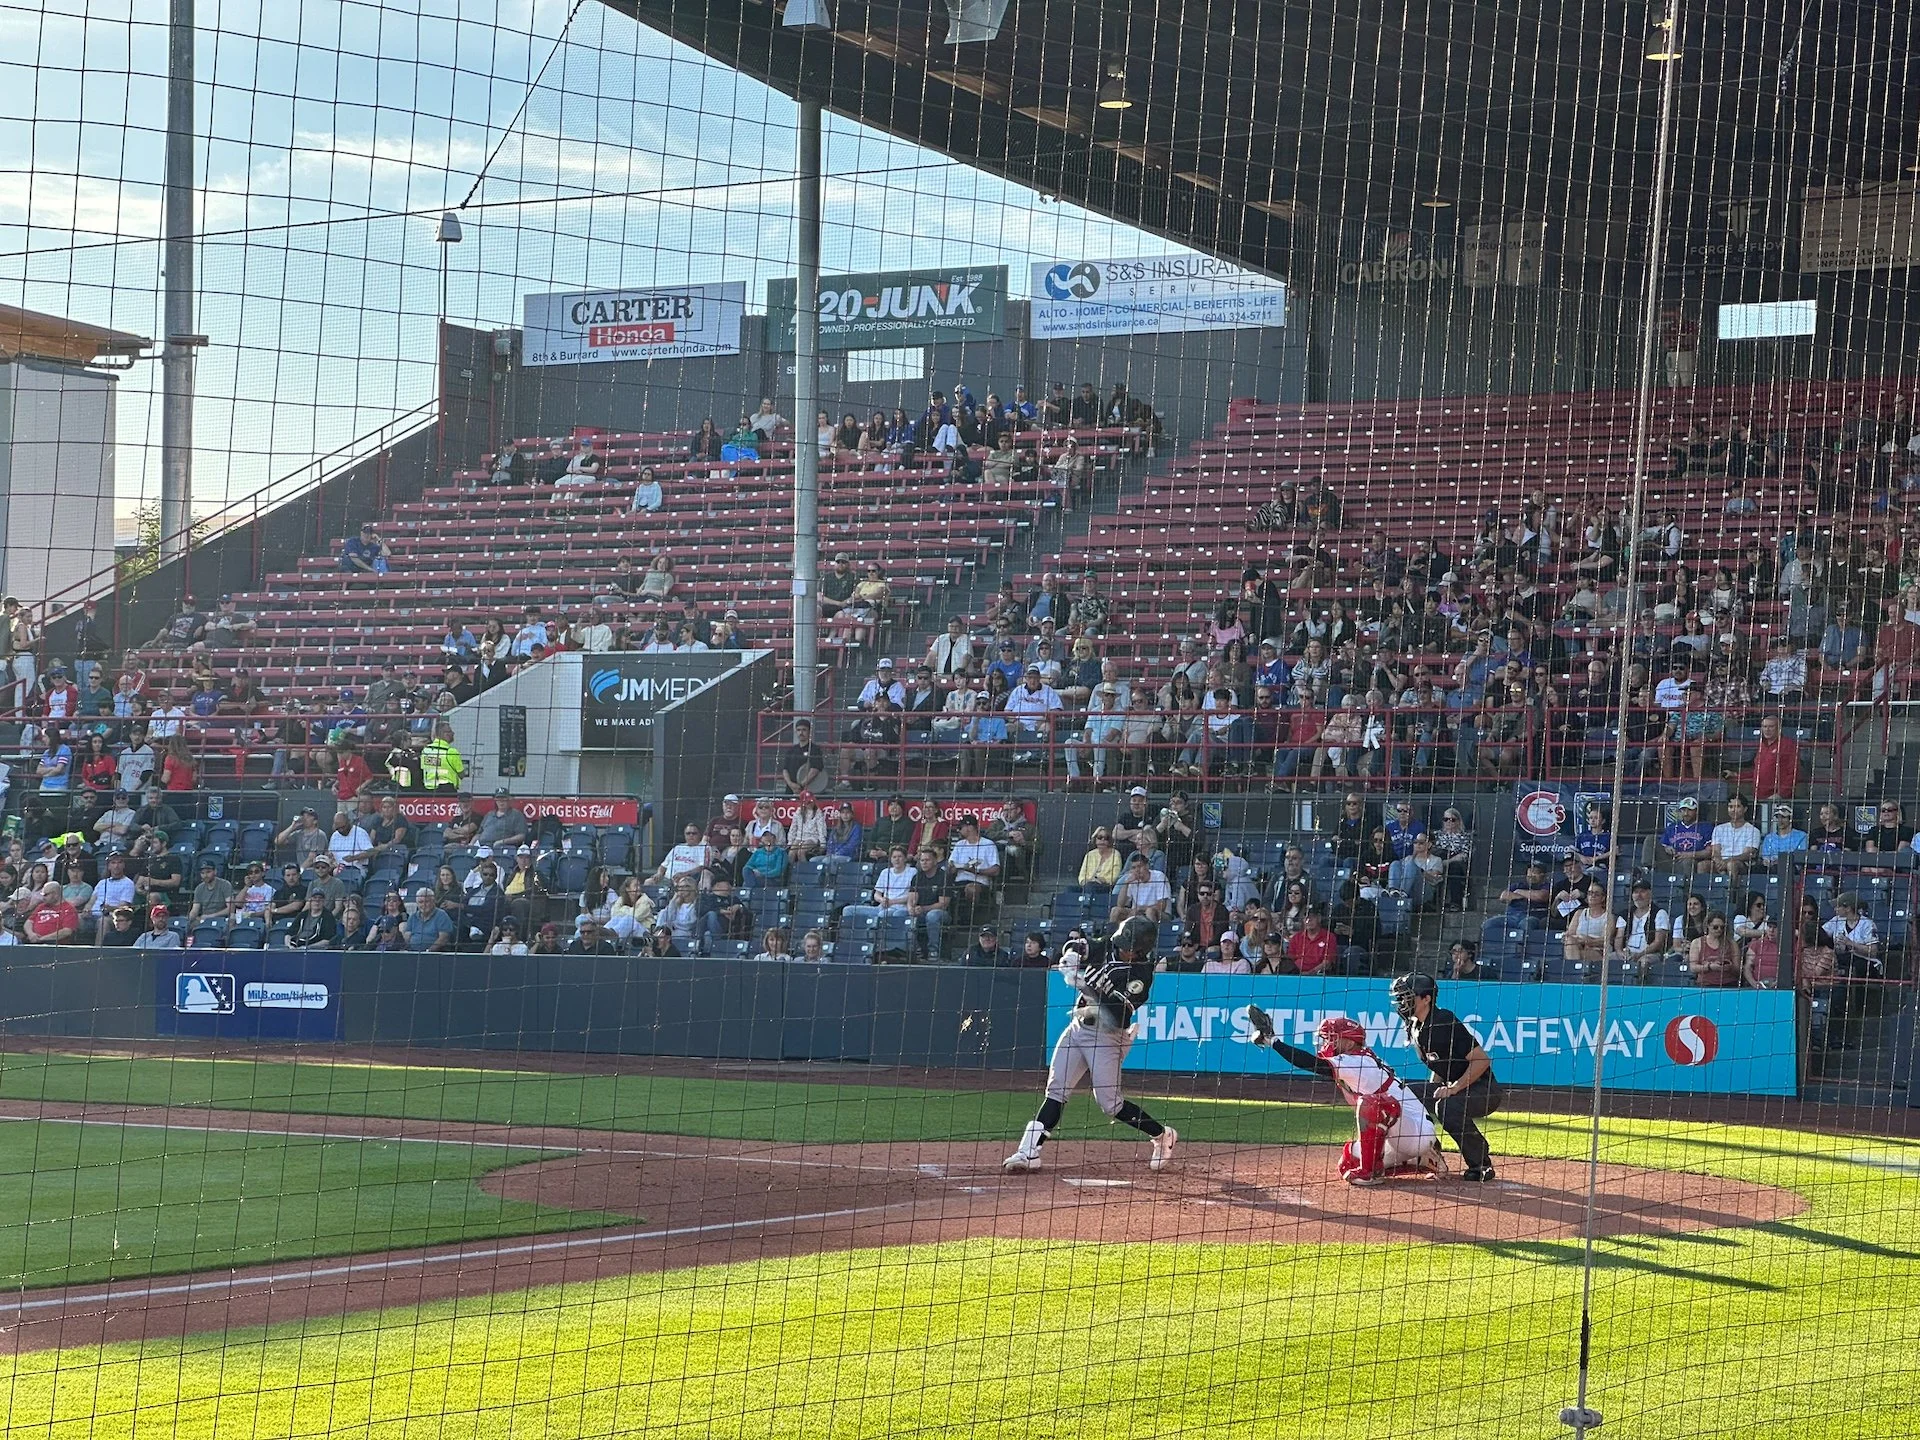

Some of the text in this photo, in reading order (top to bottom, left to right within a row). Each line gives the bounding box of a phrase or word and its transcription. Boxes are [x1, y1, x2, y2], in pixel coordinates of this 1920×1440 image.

[1105, 262, 1145, 282] S&S
[571, 296, 693, 325] CARTER
[1038, 308, 1068, 319] AUTO
[1076, 306, 1106, 318] HOME
[1114, 301, 1185, 314] COMMERCIAL
[1193, 297, 1245, 310] BENEFITS
[1254, 296, 1277, 306] LIFE
[1042, 317, 1159, 332] www.sandsinsurance.ca
[596, 326, 666, 345] Honda
[532, 342, 731, 362] 8th & Burrard www.carterhonda.com
[611, 718, 636, 726] MAKE
[399, 803, 446, 816] ROGERS
[538, 804, 614, 818] ROGERS Field
[247, 988, 324, 1002] MiLB.com/tickets
[1137, 1005, 1256, 1044] HAT'S
[1462, 1013, 1656, 1058] SAFEWAY
